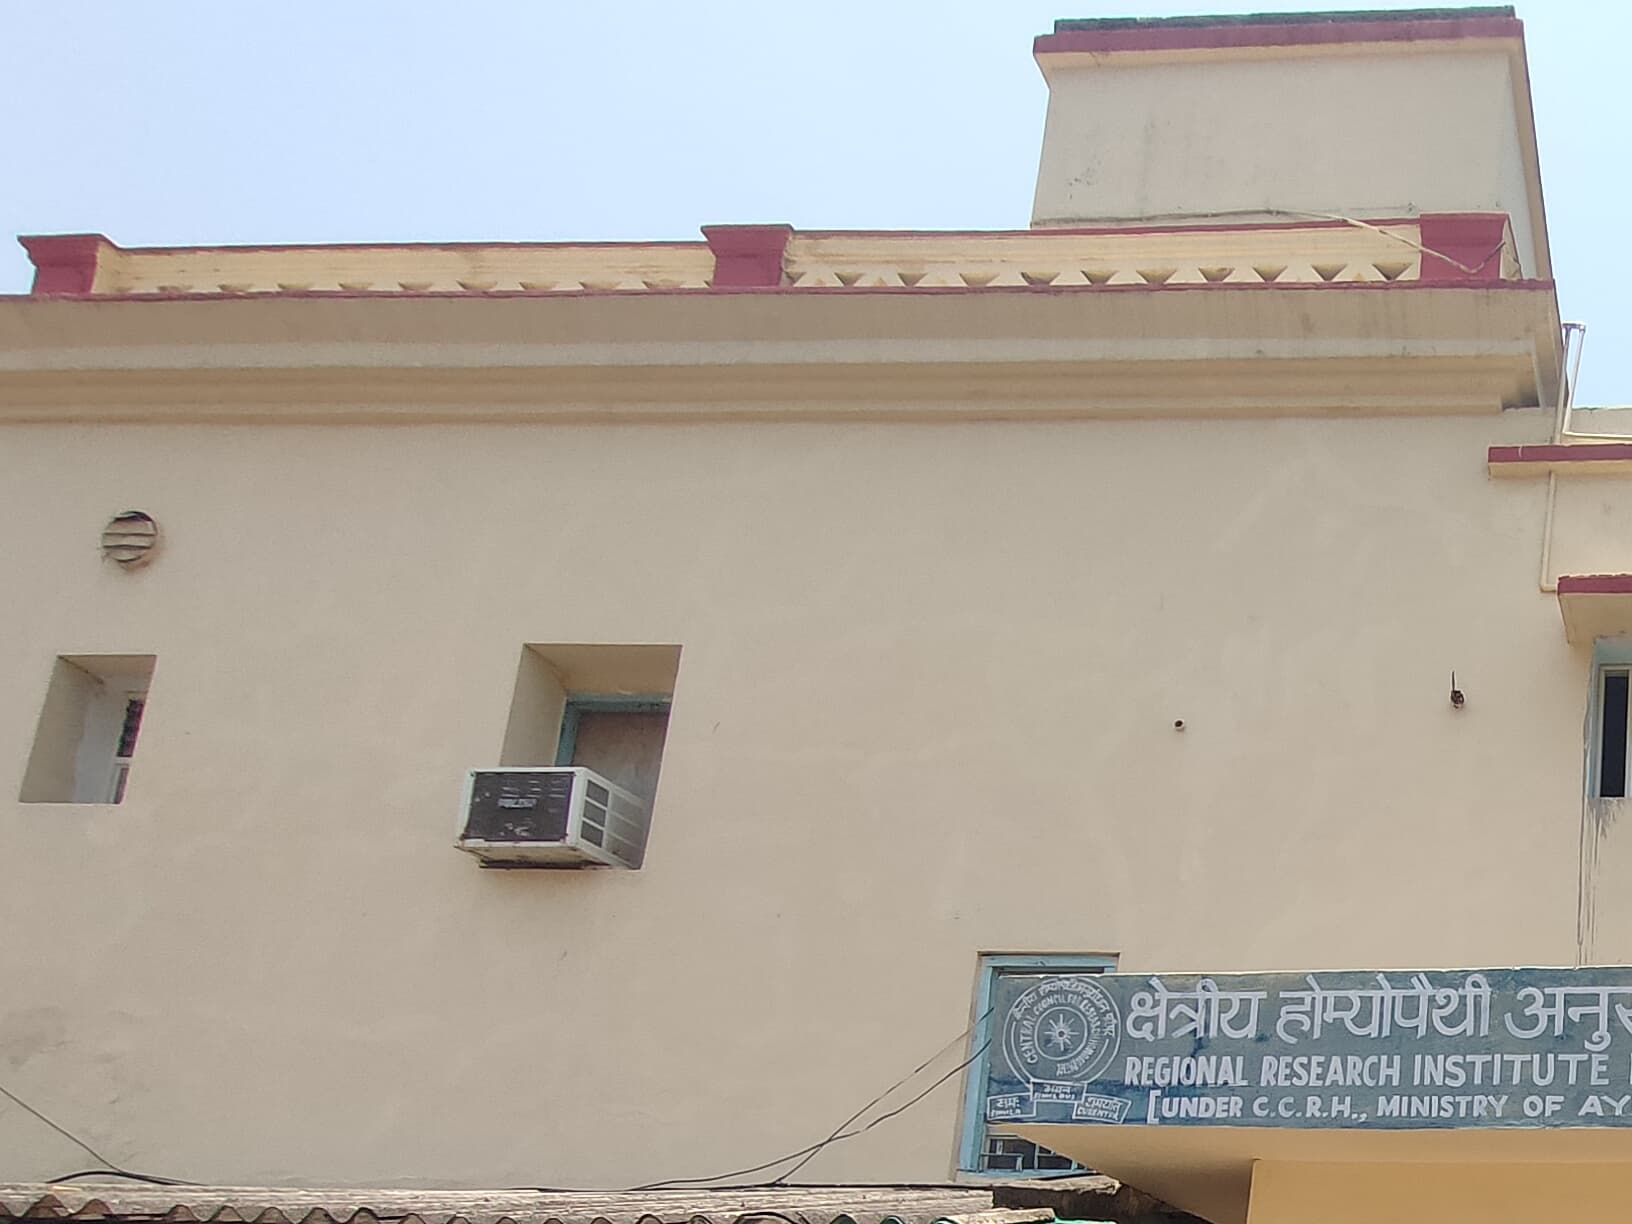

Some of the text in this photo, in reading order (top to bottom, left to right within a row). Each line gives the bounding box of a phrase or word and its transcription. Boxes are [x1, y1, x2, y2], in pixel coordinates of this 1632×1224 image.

[1126, 975, 1268, 1043] क्षेत्रीय
[1276, 973, 1492, 1044] होम्योपैथी
[1124, 1055, 1249, 1088] REGIONAL
[1260, 1054, 1401, 1088] RESEARCH
[1413, 1052, 1611, 1087] INSTITUTE
[1377, 1094, 1508, 1118] MINISTRY
[1529, 1095, 1565, 1117] OF
